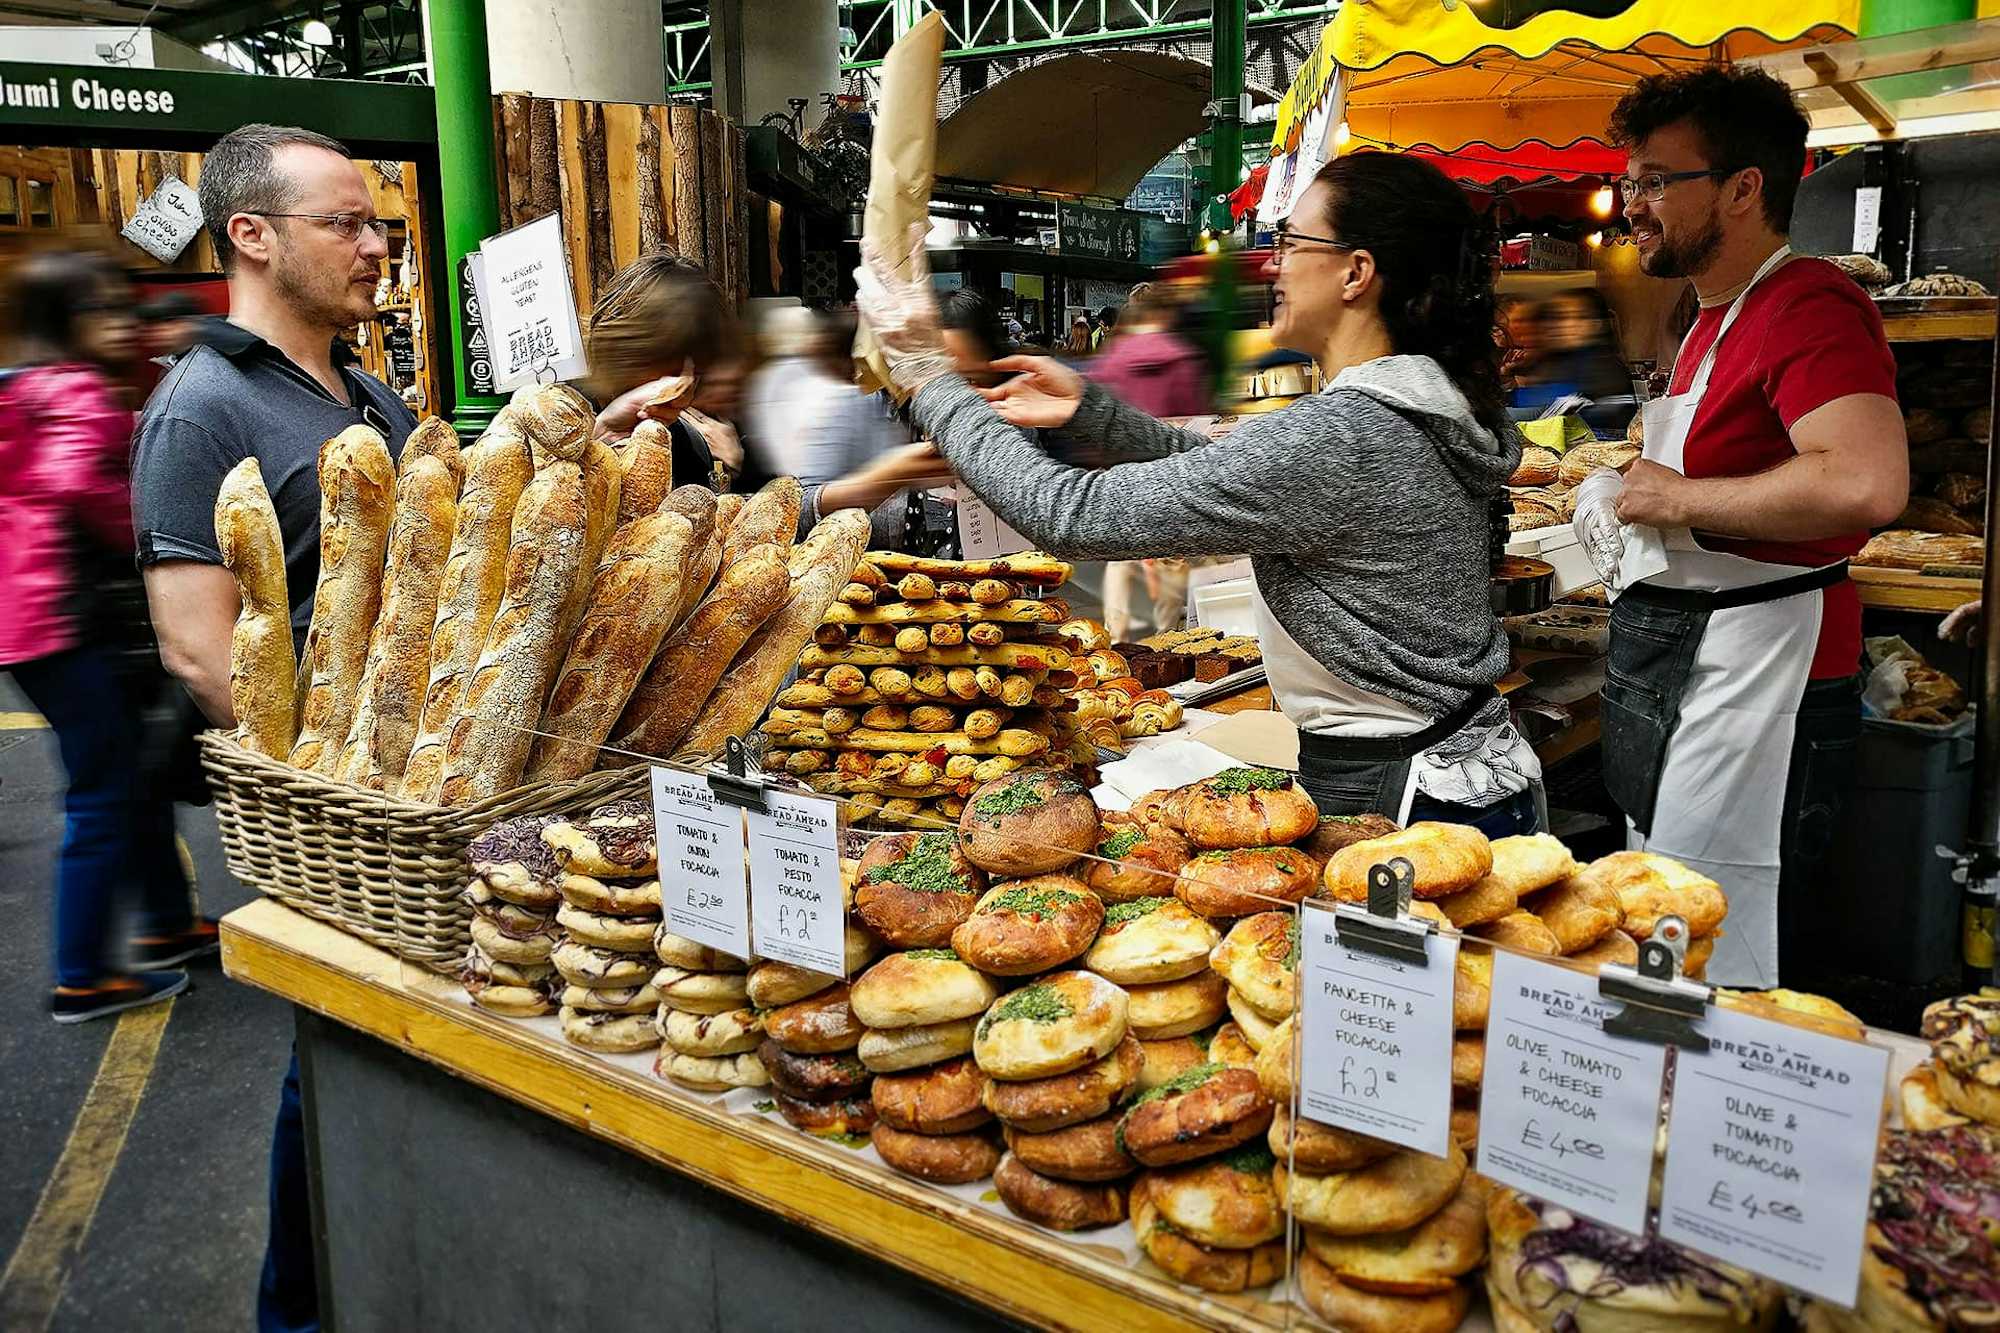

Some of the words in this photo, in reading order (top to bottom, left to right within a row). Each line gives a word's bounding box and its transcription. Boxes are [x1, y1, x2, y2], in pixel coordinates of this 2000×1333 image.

[72, 78, 175, 114] Cheese
[510, 325, 553, 351] BREAD
[511, 338, 555, 363] AHEAD
[664, 785, 693, 798] BREAD
[676, 824, 708, 840] TOMATO
[712, 832, 718, 844] &
[795, 814, 828, 828] AHEAD
[680, 859, 720, 879] FOCACCIA
[774, 848, 809, 865] TOMATO
[813, 856, 820, 868] &
[784, 867, 812, 883] PESTO
[778, 883, 822, 903] FOCACCIA
[1324, 981, 1397, 1012] PANCETTA
[1404, 1002, 1414, 1016] &
[1520, 986, 1575, 1011] BREAD
[1340, 1008, 1396, 1034] CHEESE
[1335, 1029, 1401, 1058] FOCACCIA
[1561, 1049, 1622, 1081] TOMATO
[1711, 1038, 1775, 1065] BREAD
[1782, 1058, 1851, 1085] AHEAD
[1519, 1060, 1531, 1077] &
[1538, 1067, 1603, 1099] CHEESE
[1522, 1084, 1596, 1123] FOCACCIA
[1725, 1096, 1775, 1123] OLIVE
[1784, 1113, 1798, 1132] &
[1725, 1121, 1794, 1155] TOMATO
[1712, 1143, 1801, 1182] FOCACCIA
